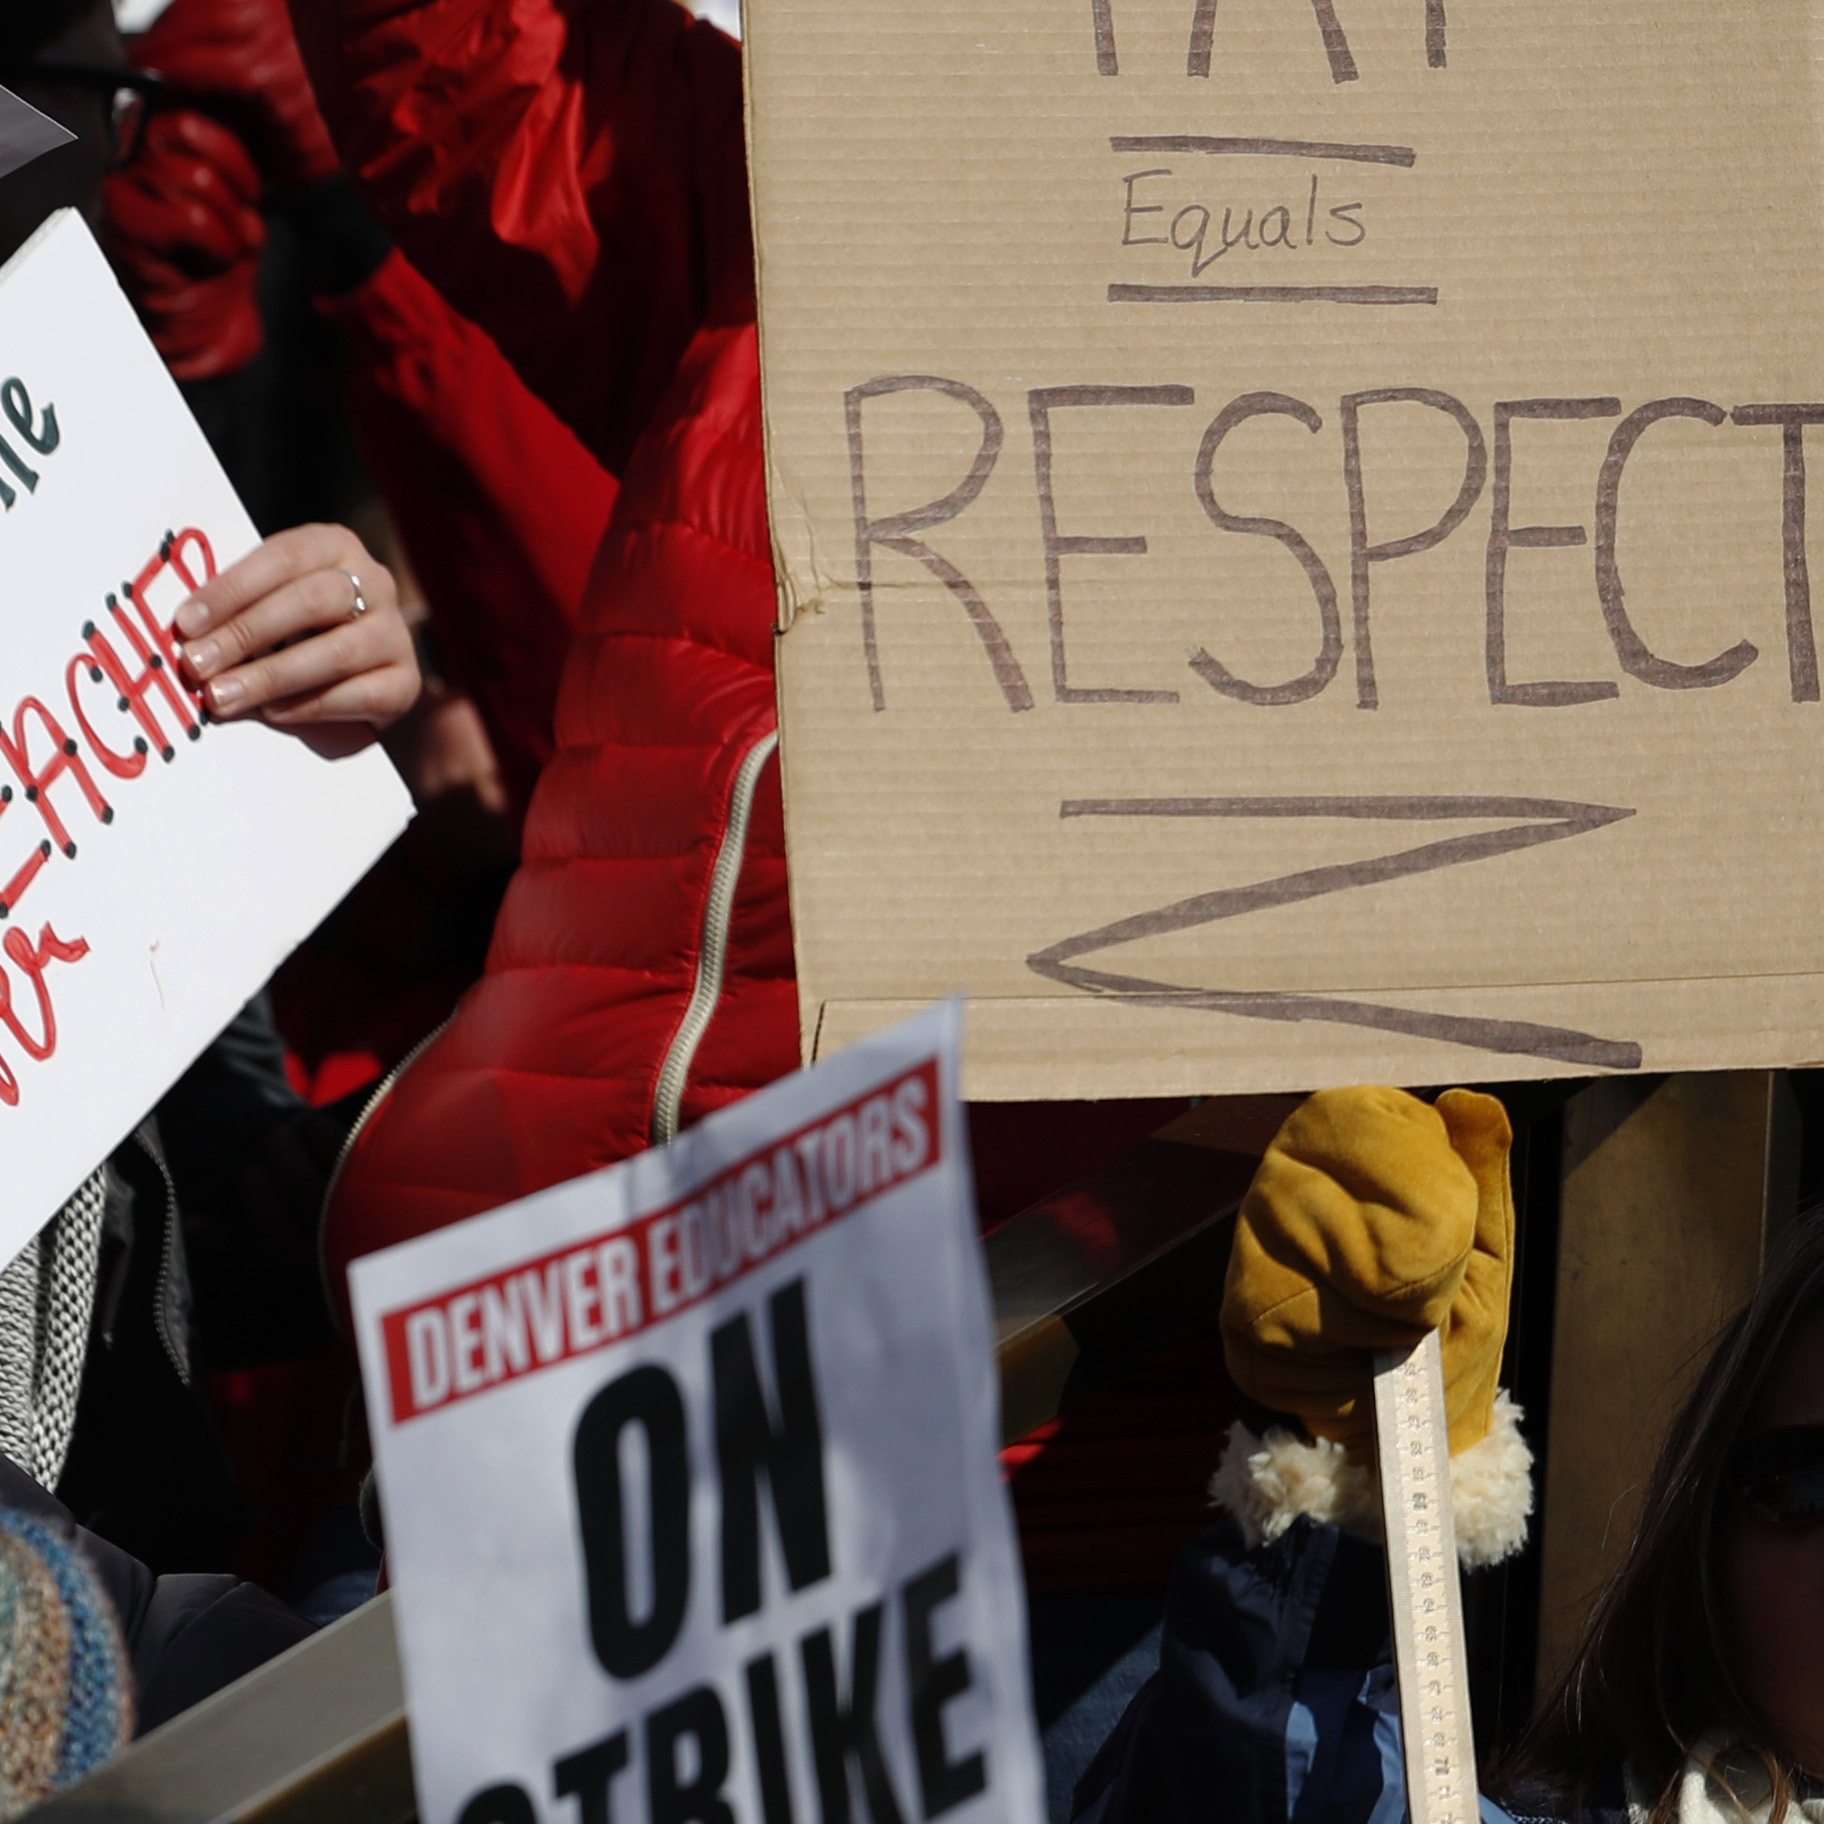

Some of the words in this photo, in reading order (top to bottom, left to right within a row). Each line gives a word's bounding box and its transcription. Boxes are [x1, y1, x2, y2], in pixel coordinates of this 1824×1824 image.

[1118, 168, 1369, 278] Equals
[404, 1233, 644, 1411] DENVER
[647, 1074, 932, 1315] EDUCATORS
[572, 1271, 834, 1683] ON
